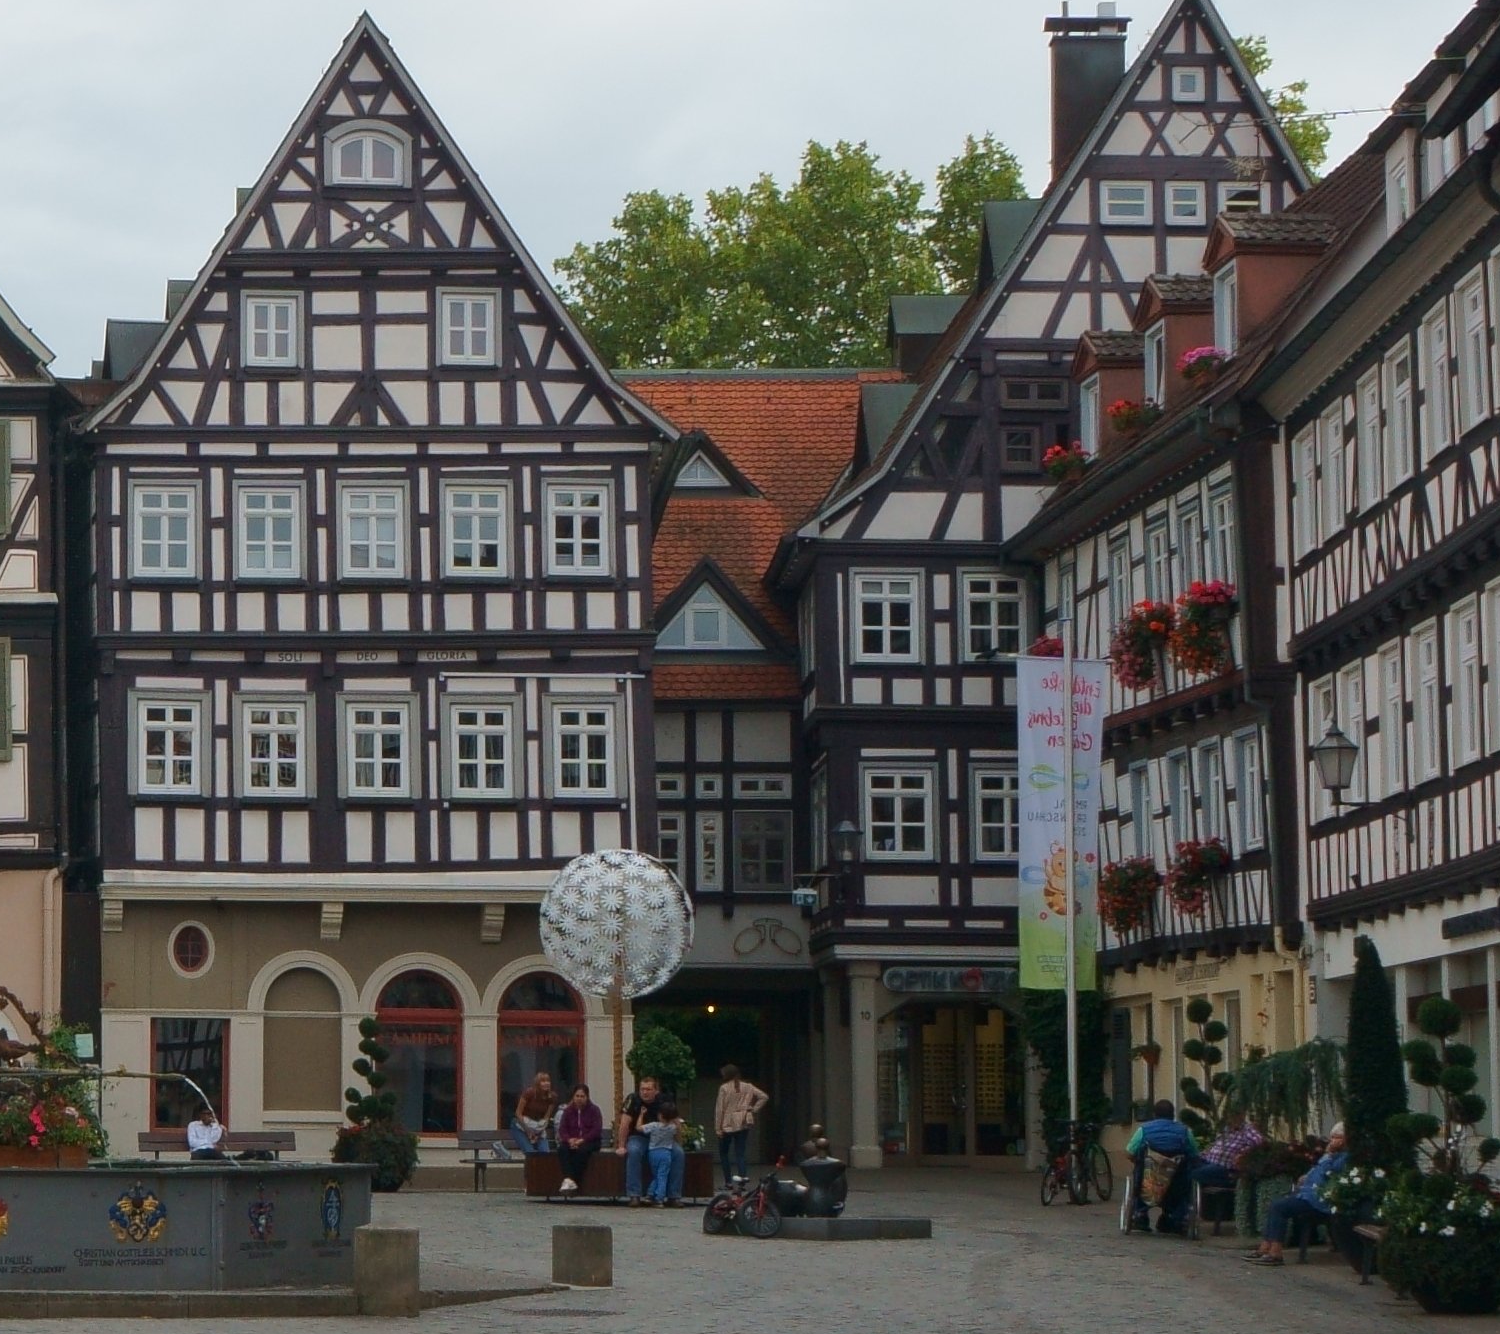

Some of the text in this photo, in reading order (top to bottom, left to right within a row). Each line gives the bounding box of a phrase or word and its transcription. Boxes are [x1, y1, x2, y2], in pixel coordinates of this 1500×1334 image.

[278, 651, 467, 662] SOLI DEO GLORIA
[74, 1248, 116, 1258] CHRISTIAN
